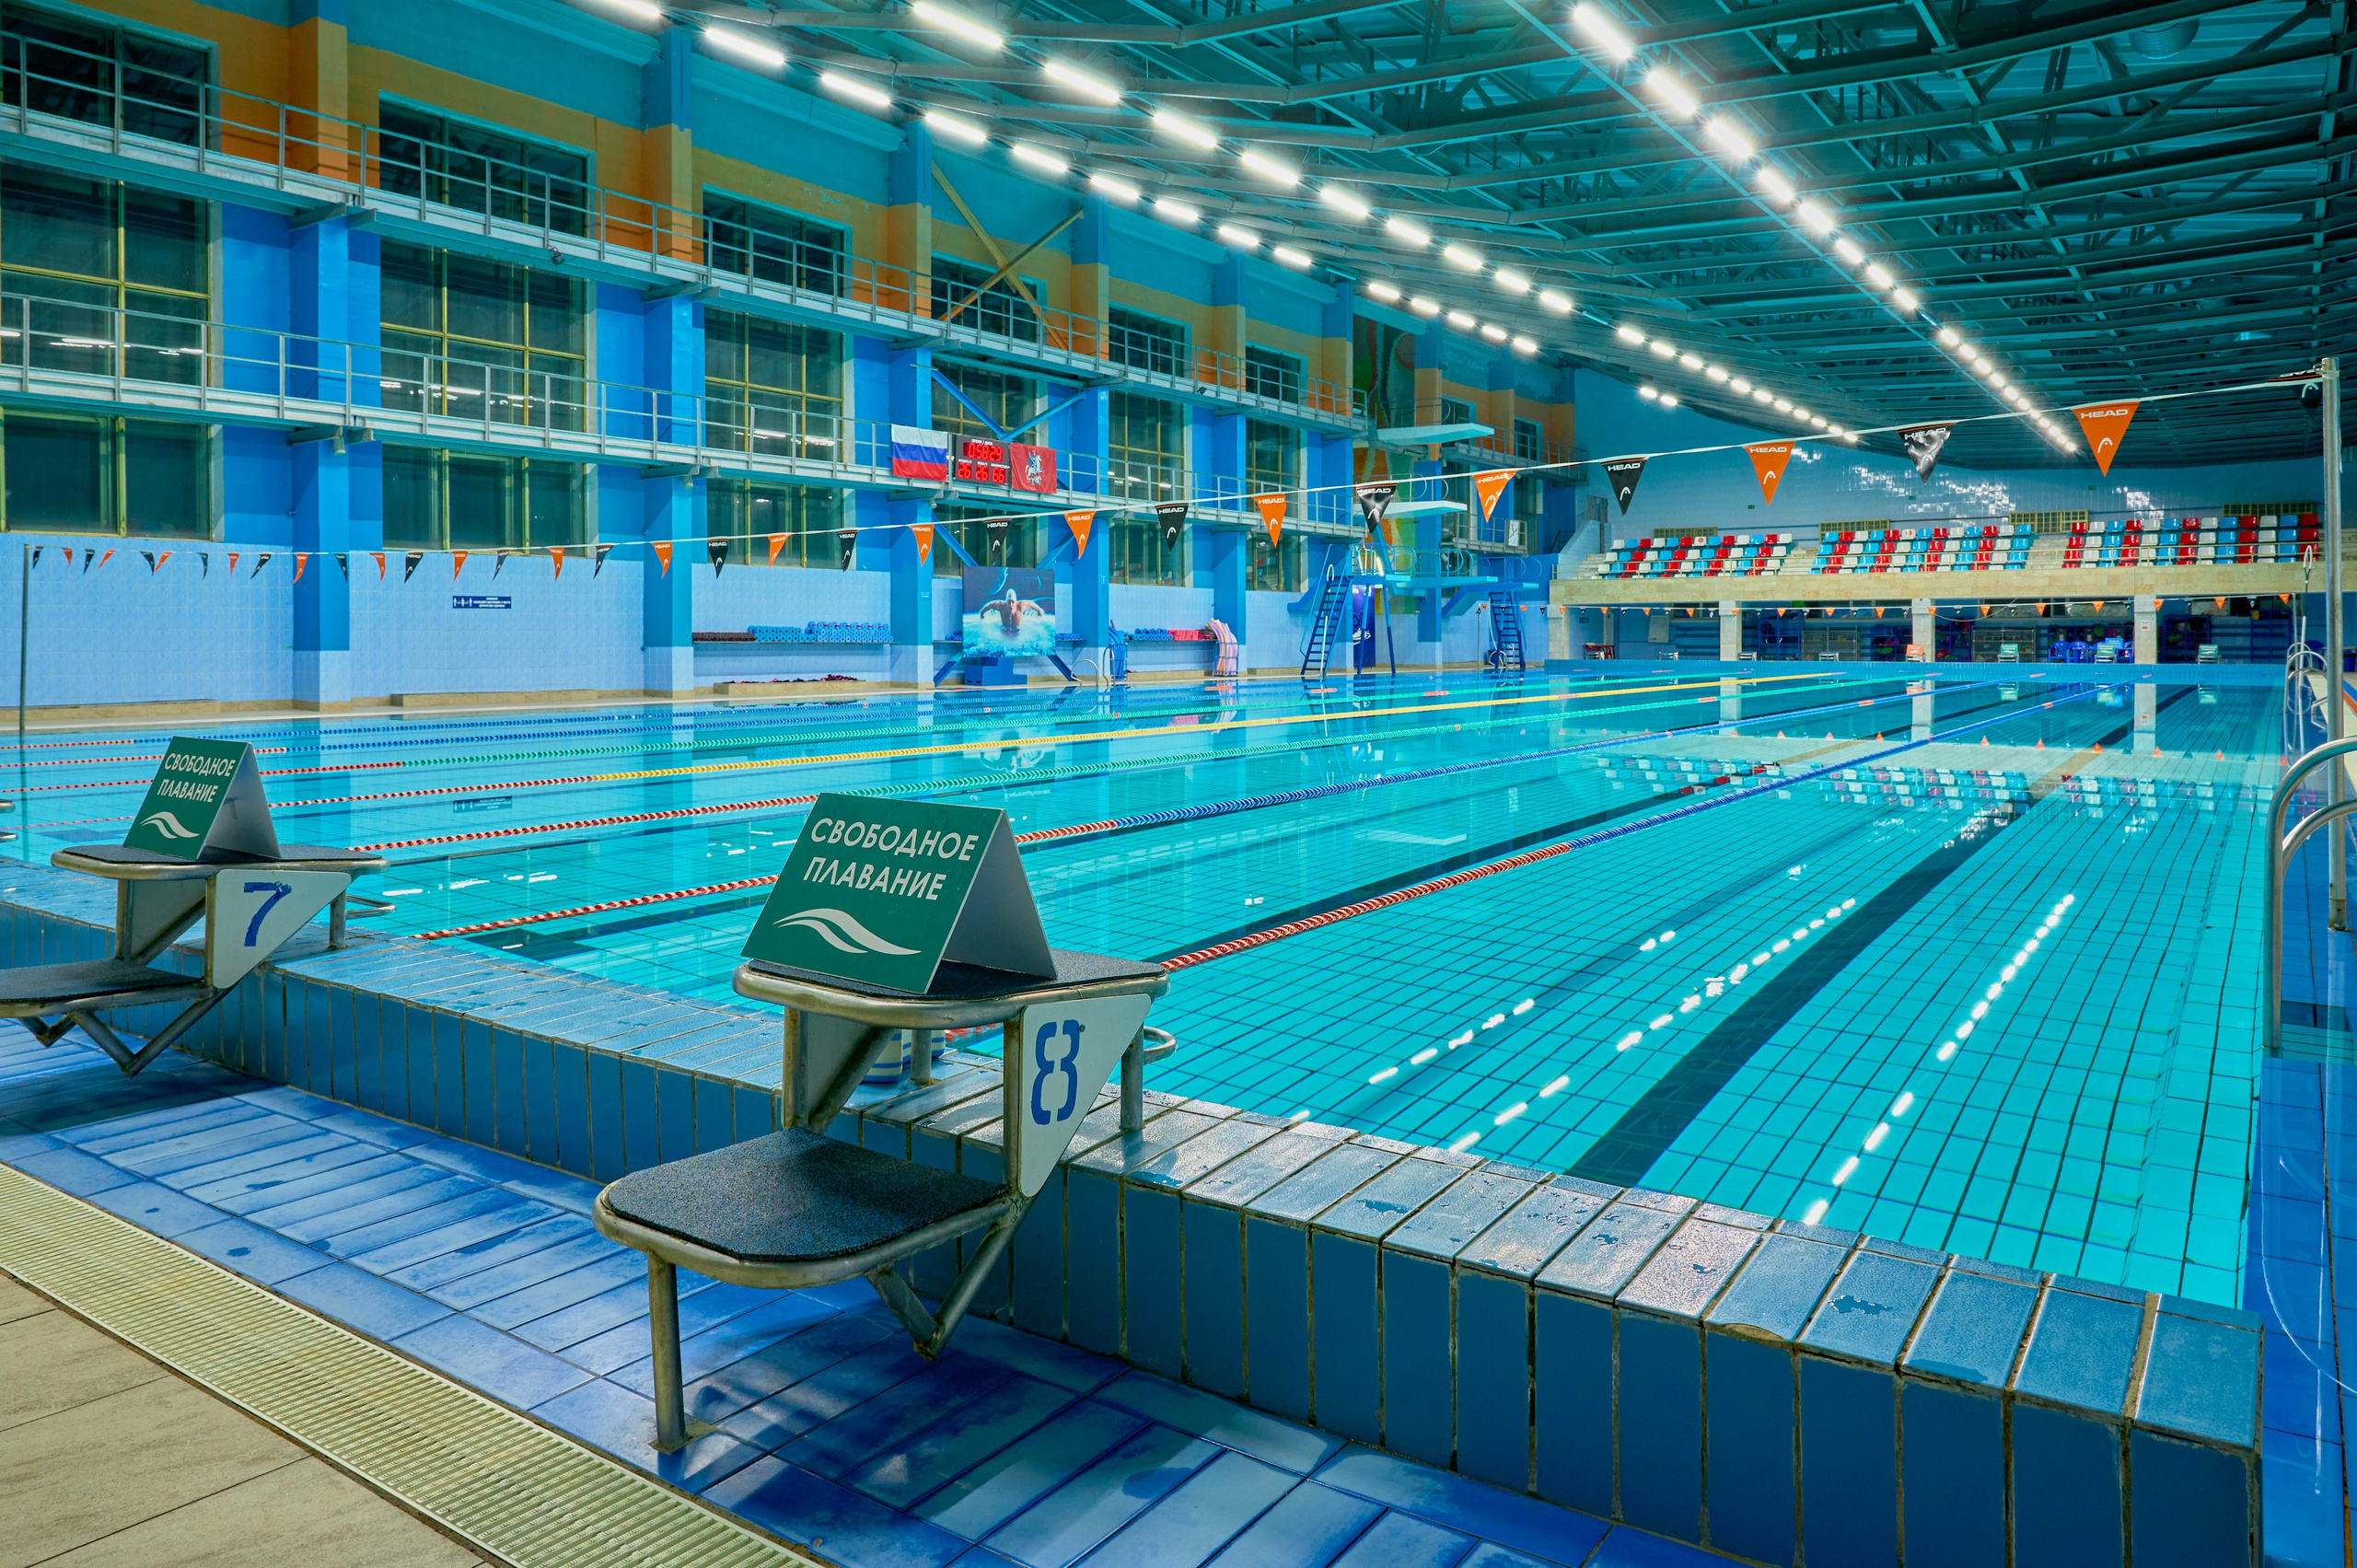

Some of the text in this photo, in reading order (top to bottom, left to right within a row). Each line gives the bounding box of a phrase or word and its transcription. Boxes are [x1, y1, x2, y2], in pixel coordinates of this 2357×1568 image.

[2080, 409, 2128, 419] HEAD
[1904, 426, 1947, 440] HEAD
[958, 462, 1006, 483] 26 26 66
[1607, 462, 1642, 471] HEAD
[165, 752, 236, 777] СВОБОДНОЕ
[157, 779, 218, 803] ПЛАВАНИЕ
[811, 818, 980, 861] СВОБОДНОЕ
[803, 856, 946, 900] ПЛАВАНИЕ
[243, 881, 293, 947] 7
[1030, 1019, 1081, 1125] 8
